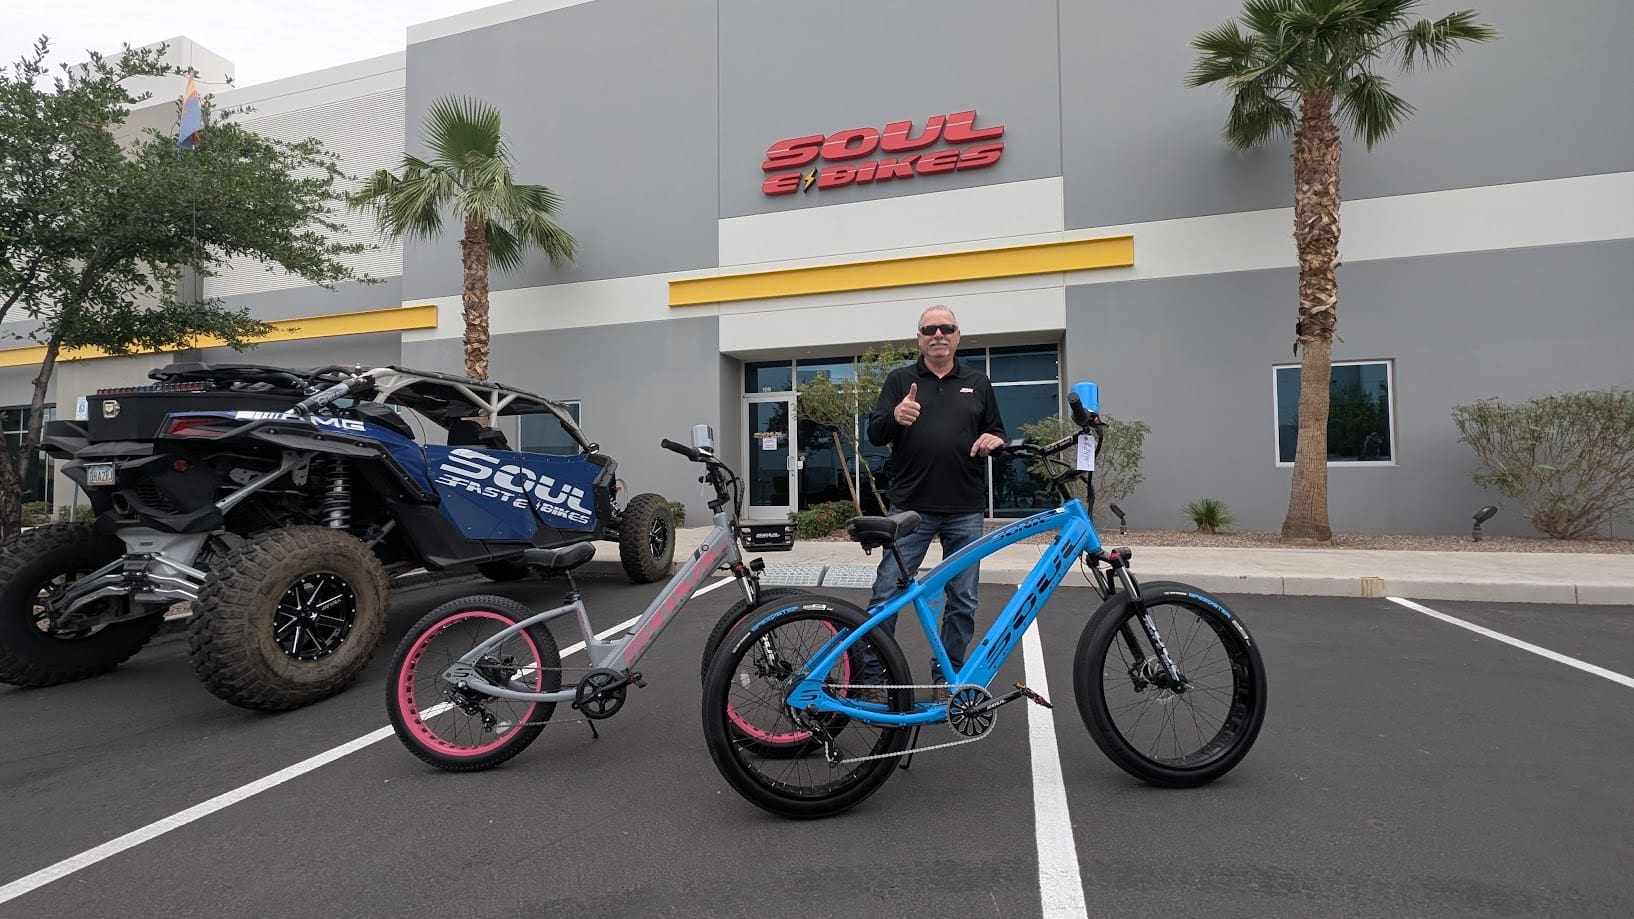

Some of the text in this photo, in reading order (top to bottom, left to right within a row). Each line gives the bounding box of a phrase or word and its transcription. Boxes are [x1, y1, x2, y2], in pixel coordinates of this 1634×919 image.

[761, 109, 1004, 172] SOUL
[440, 448, 592, 516] SOUL
[986, 529, 1087, 670] SOUL
